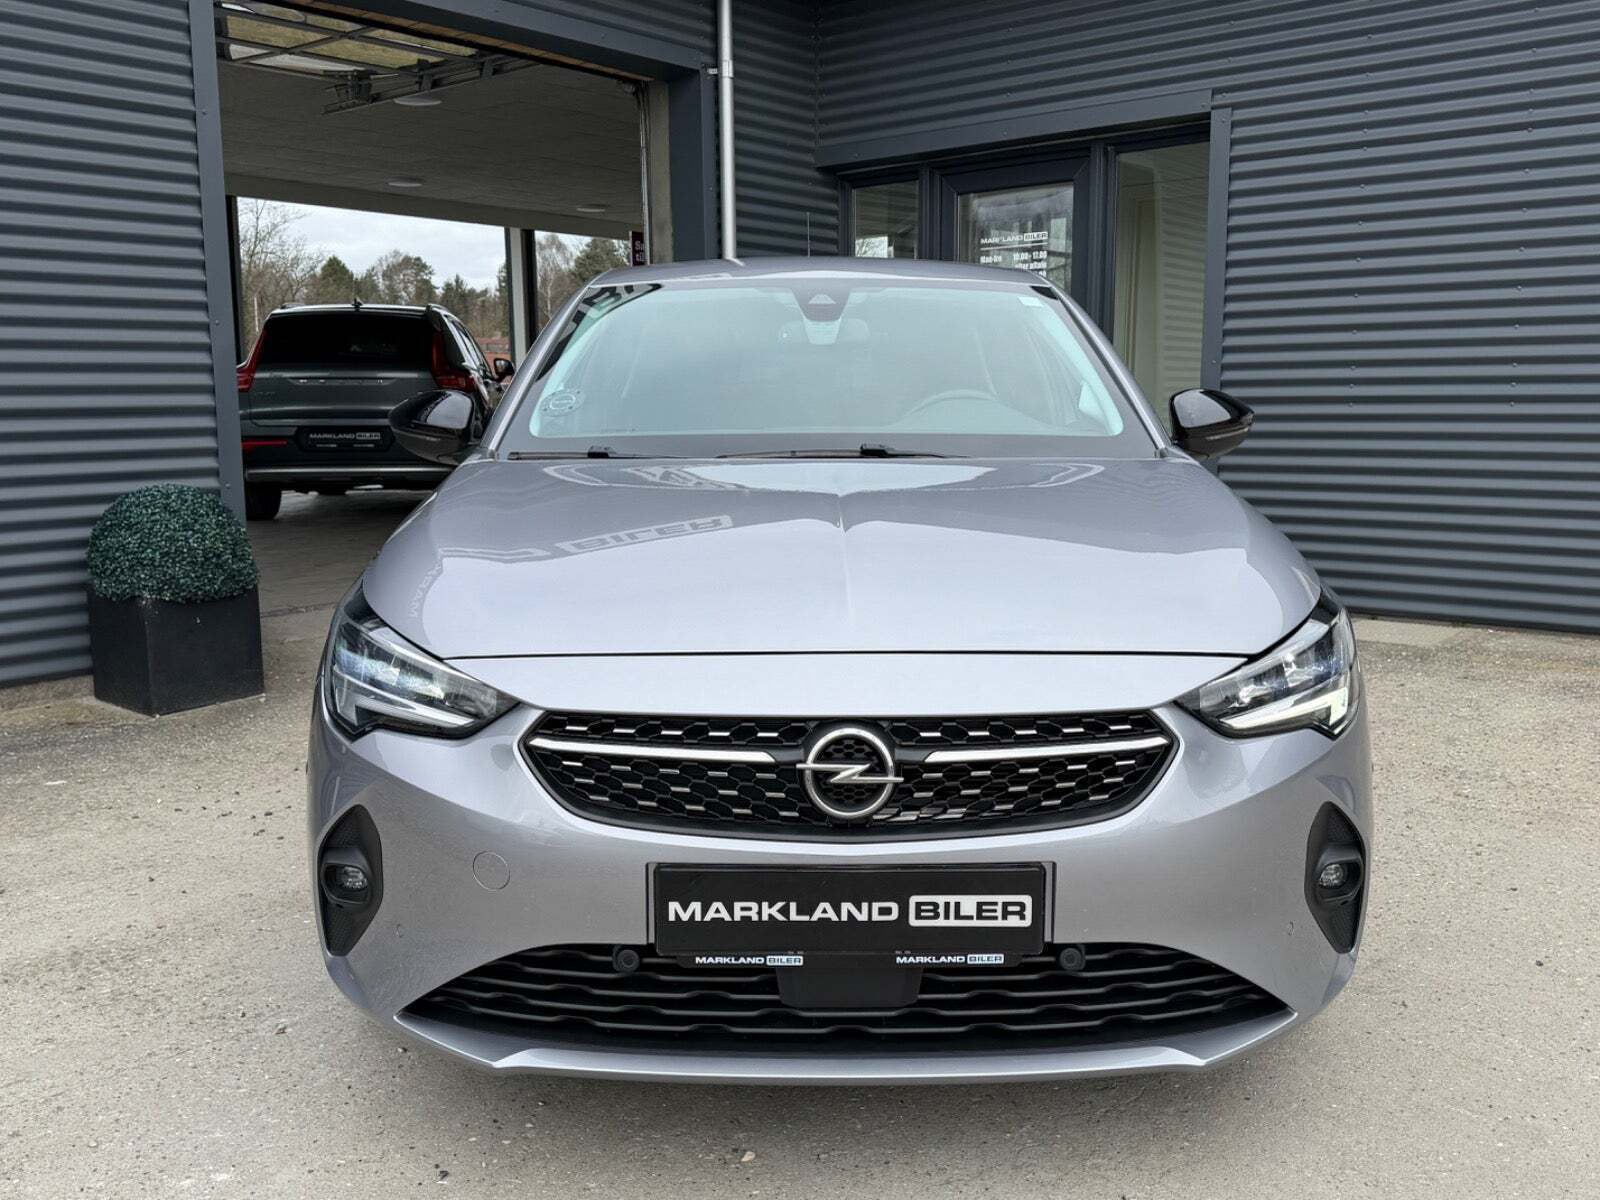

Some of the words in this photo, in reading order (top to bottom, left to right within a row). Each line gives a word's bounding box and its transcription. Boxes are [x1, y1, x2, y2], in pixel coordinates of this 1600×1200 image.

[668, 901, 899, 922] MARKLAND
[912, 899, 1028, 923] BILER
[695, 955, 765, 965] MARKLAND
[767, 955, 803, 966] BILER
[896, 954, 966, 964] MARKLAND
[968, 954, 1004, 965] BILER
